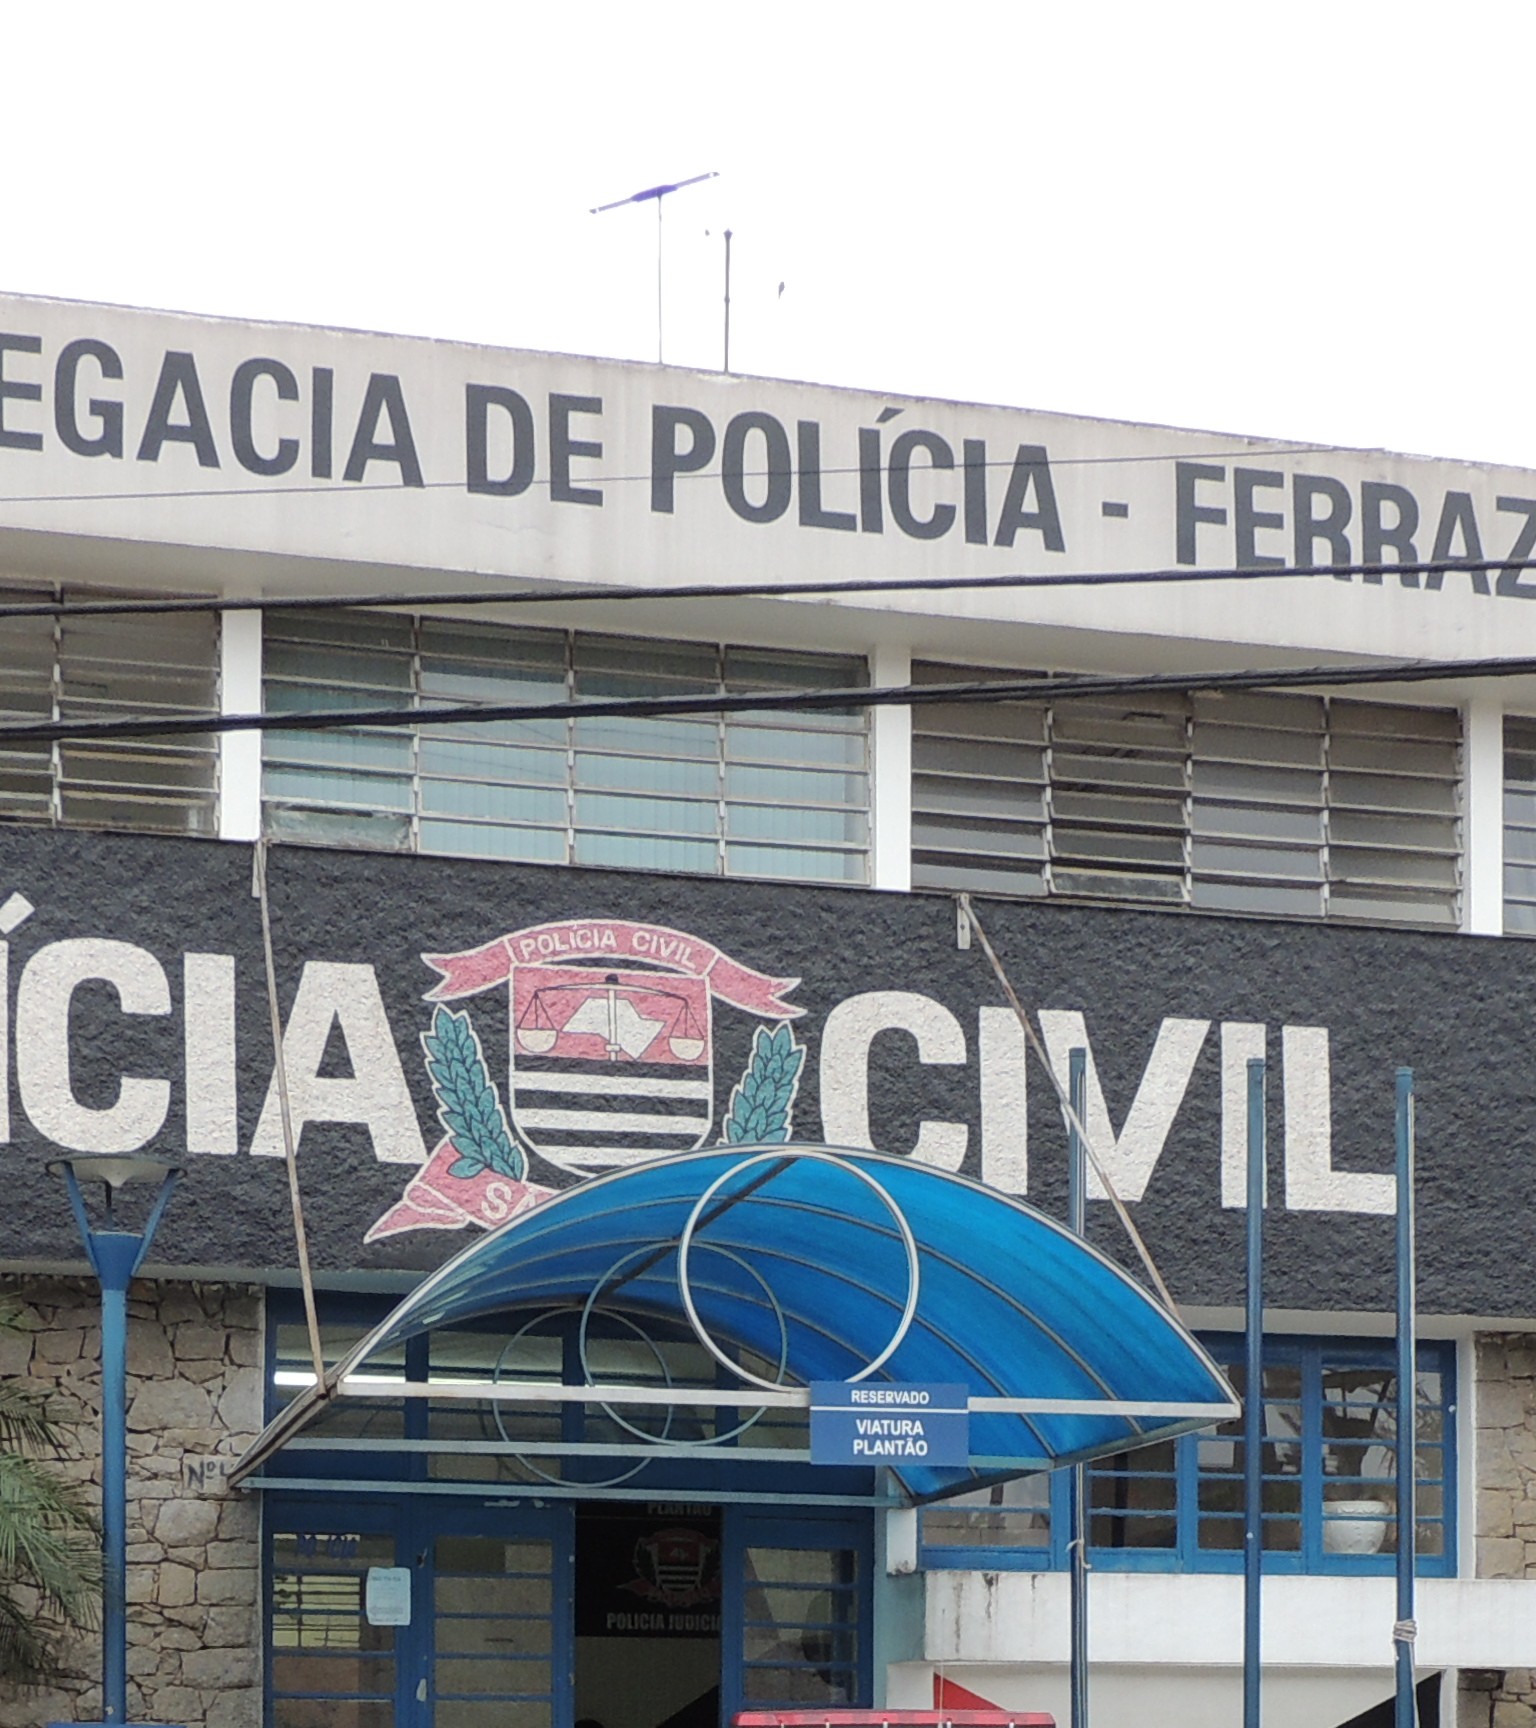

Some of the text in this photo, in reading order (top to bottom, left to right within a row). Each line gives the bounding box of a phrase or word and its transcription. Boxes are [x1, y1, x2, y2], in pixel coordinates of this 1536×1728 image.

[465, 382, 603, 507] DE
[650, 404, 1065, 553] POLÍCIA
[632, 930, 696, 969] CIVIL
[819, 991, 1397, 1214] CIVIL
[851, 1390, 930, 1404] RESERVADO
[855, 1419, 924, 1436] VIATURA
[853, 1437, 928, 1456] PLANTÃO
